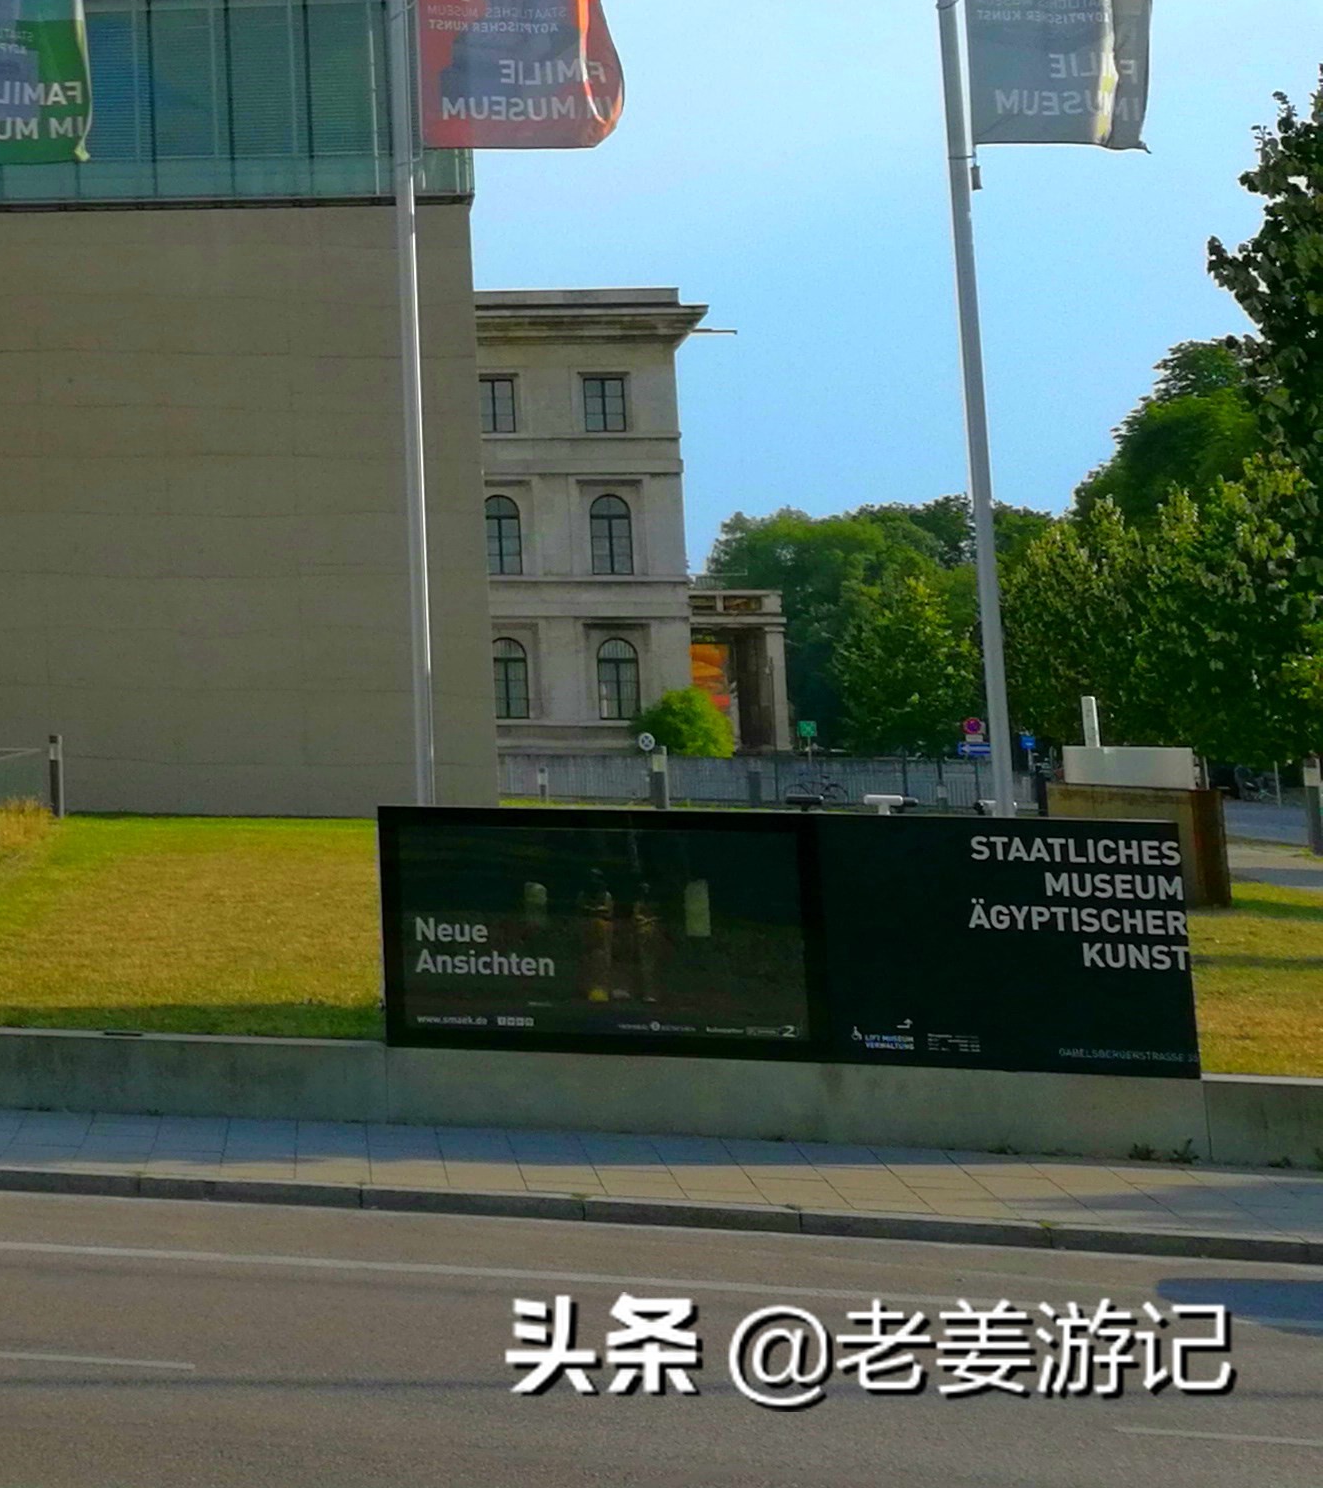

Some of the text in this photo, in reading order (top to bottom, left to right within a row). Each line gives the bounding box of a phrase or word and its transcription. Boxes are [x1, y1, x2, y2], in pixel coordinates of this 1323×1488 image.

[970, 835, 1181, 866] STAATLICHES
[1045, 872, 1184, 901] MUSEUM
[415, 917, 488, 944] Neue
[968, 898, 1188, 936] ÄGYPTISCHER
[416, 949, 555, 977] Ansichten
[1082, 942, 1190, 971] KUNST
